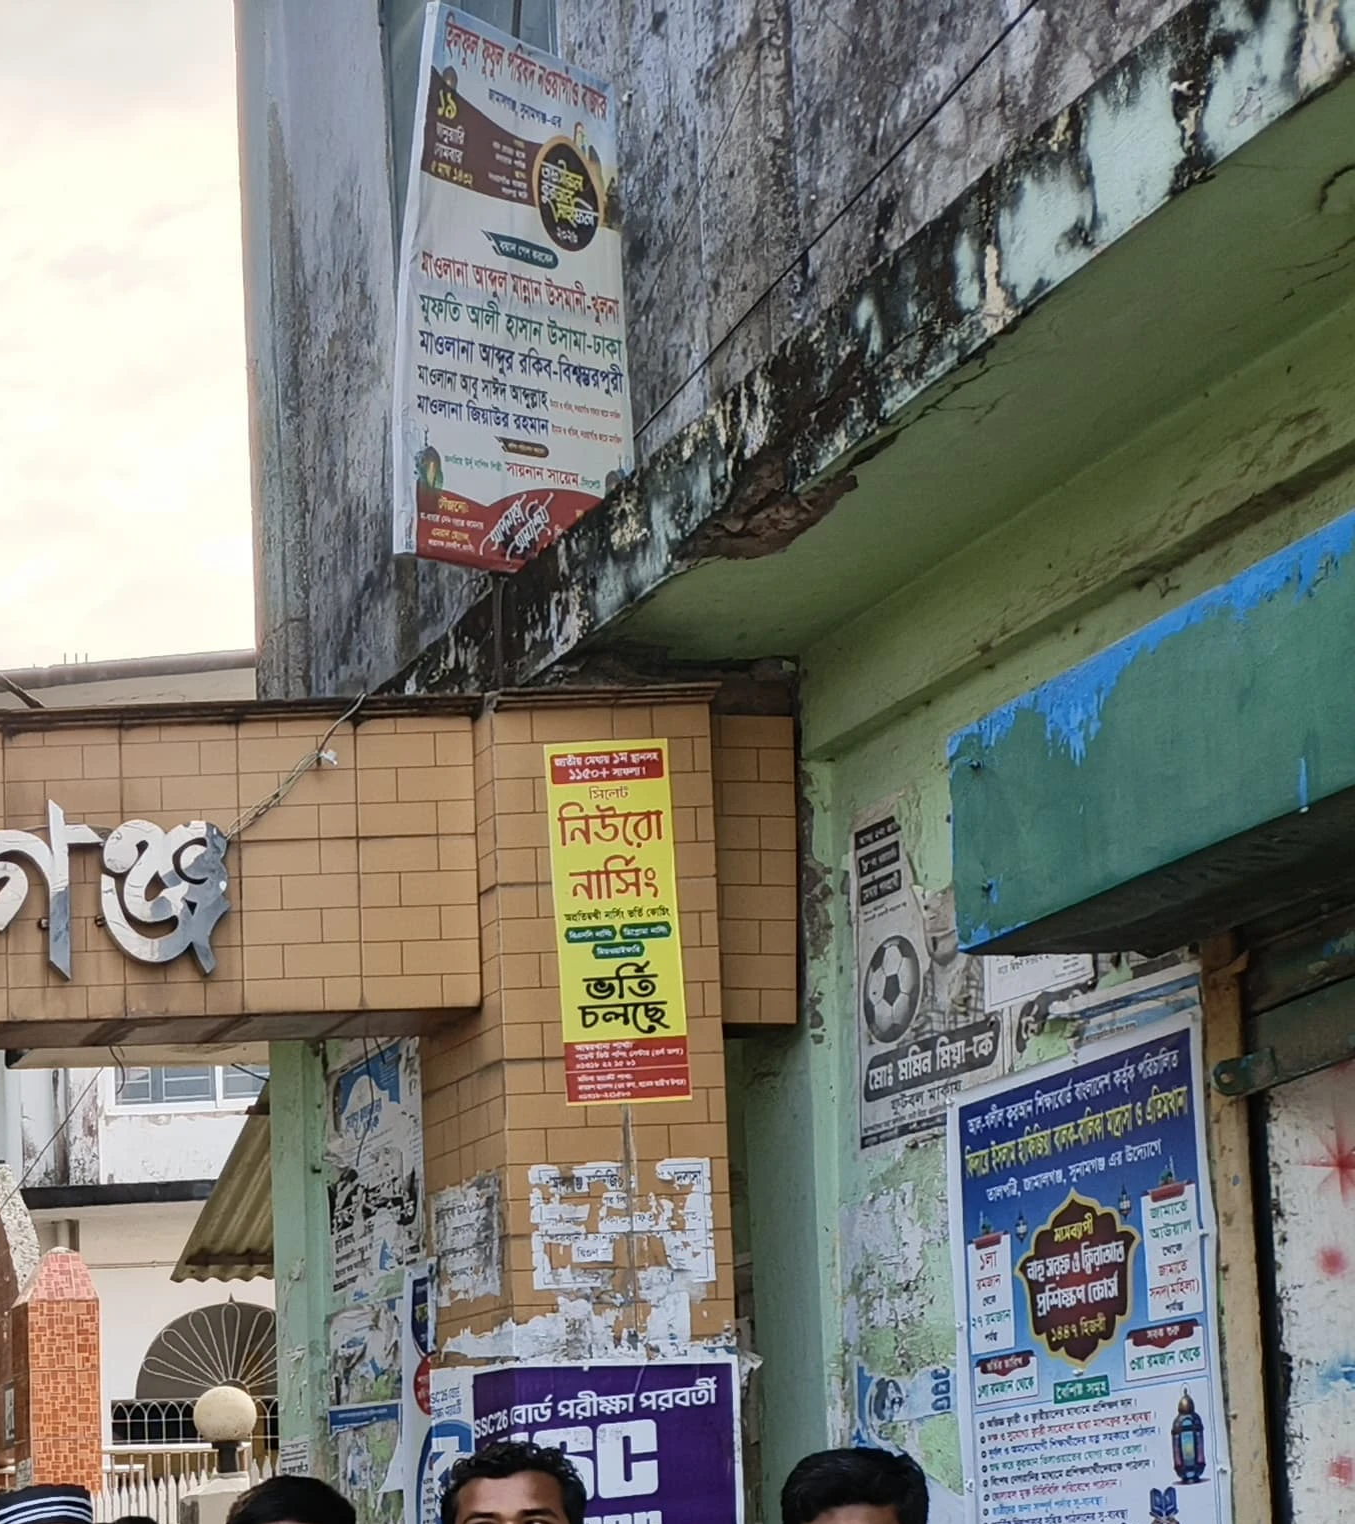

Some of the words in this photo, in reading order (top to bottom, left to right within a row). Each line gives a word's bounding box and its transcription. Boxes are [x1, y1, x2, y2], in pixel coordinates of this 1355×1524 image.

[421, 251, 468, 288] মাওলানা
[419, 291, 463, 325] মুফতি
[467, 300, 501, 335] আলী
[505, 312, 543, 343] হাসান
[419, 330, 475, 363] মাওলানা
[417, 364, 457, 392] মাওলানা
[460, 372, 478, 400] আবু
[417, 394, 463, 422] মাওলানা
[466, 400, 509, 429] জিয়াউর
[513, 413, 549, 436] রহমান
[589, 786, 629, 801] সিলেট
[558, 802, 663, 848] নিউরো
[569, 855, 659, 900] নার্সিং
[583, 961, 658, 1000] ভর্তি
[578, 1001, 670, 1033] চলছে
[869, 1062, 893, 1090] মোঃ
[897, 1045, 932, 1081] মমিন
[1088, 1270, 1119, 1304] কোর্স
[510, 1394, 553, 1426] বোর্ড
[558, 1391, 634, 1420] পরীক্ষা
[639, 1376, 718, 1411] পরবর্তী
[501, 1419, 658, 1500] SC
